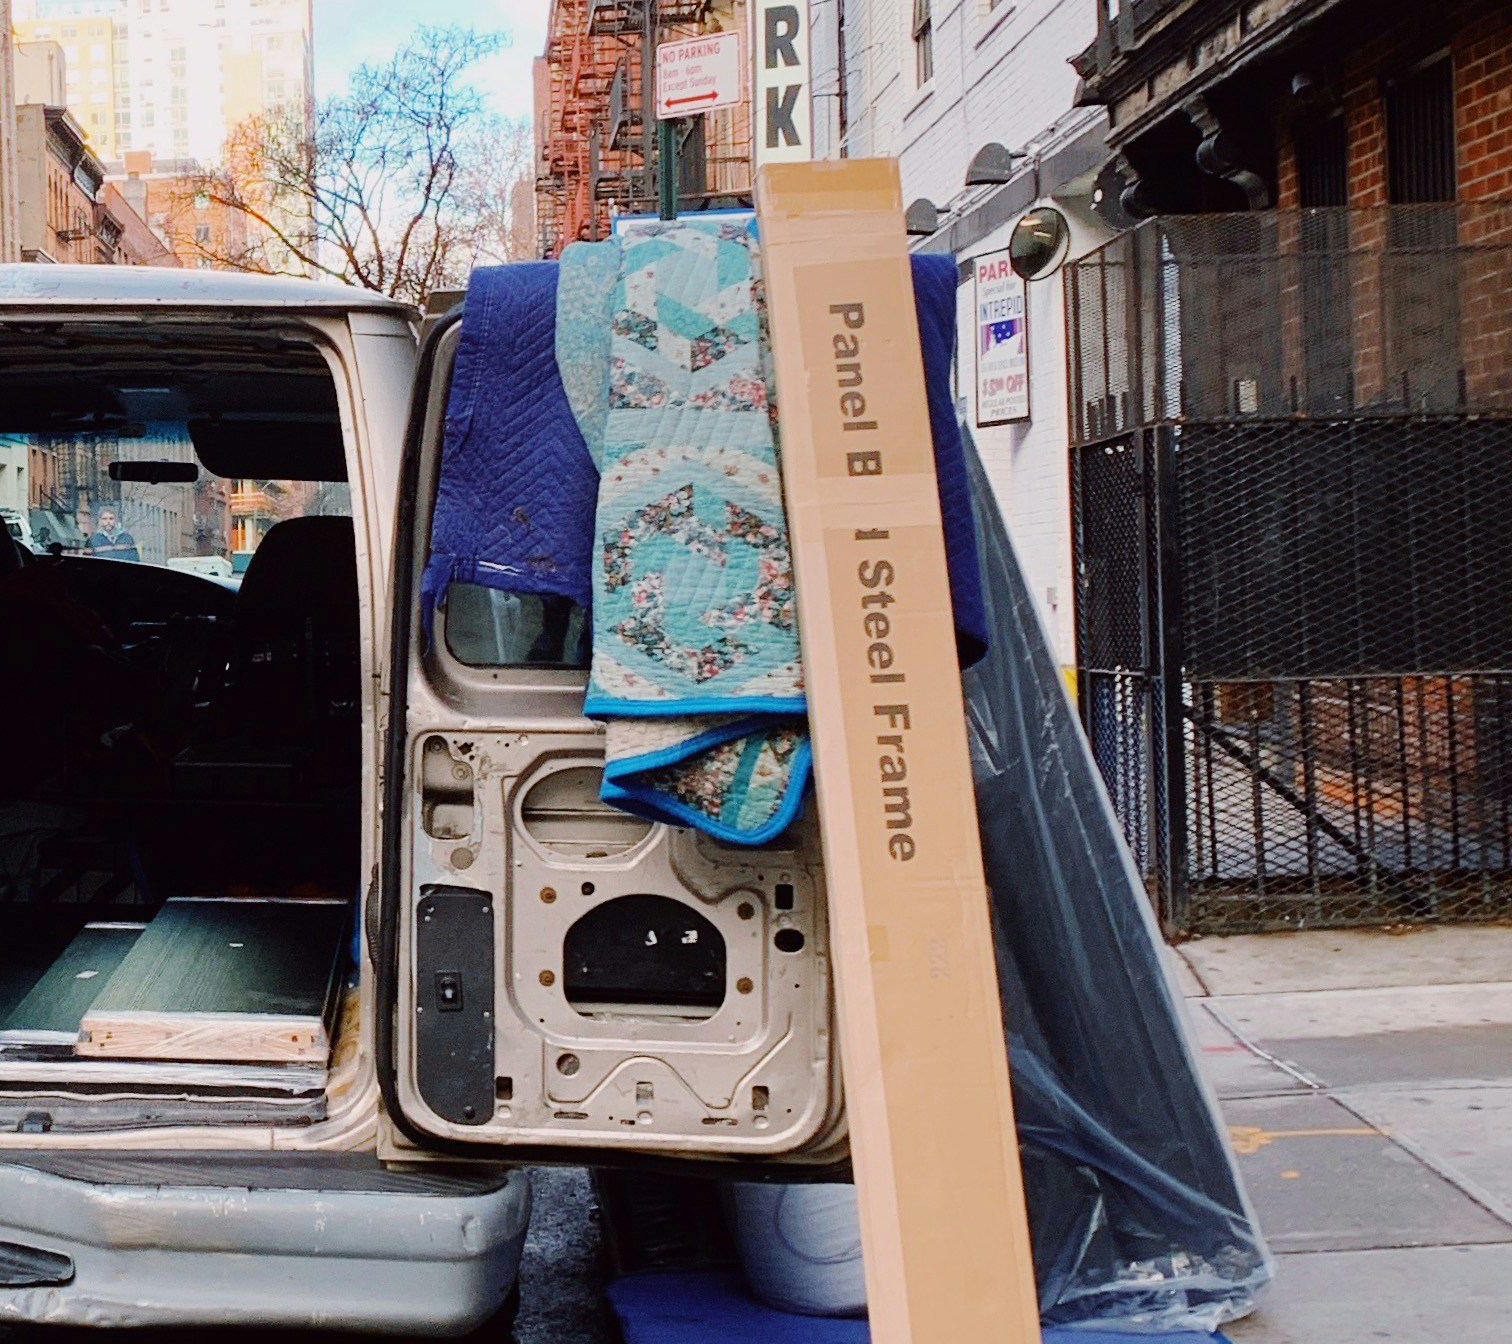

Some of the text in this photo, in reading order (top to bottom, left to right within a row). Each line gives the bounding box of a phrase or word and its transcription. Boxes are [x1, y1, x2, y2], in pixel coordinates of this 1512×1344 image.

[662, 42, 721, 64] NO PARKING
[663, 76, 717, 93] Except Sunday
[979, 260, 1014, 284] PAR
[979, 295, 1022, 322] INTREPID
[829, 302, 878, 432] Panel
[857, 559, 906, 684] Steel
[873, 703, 917, 863] Frame
